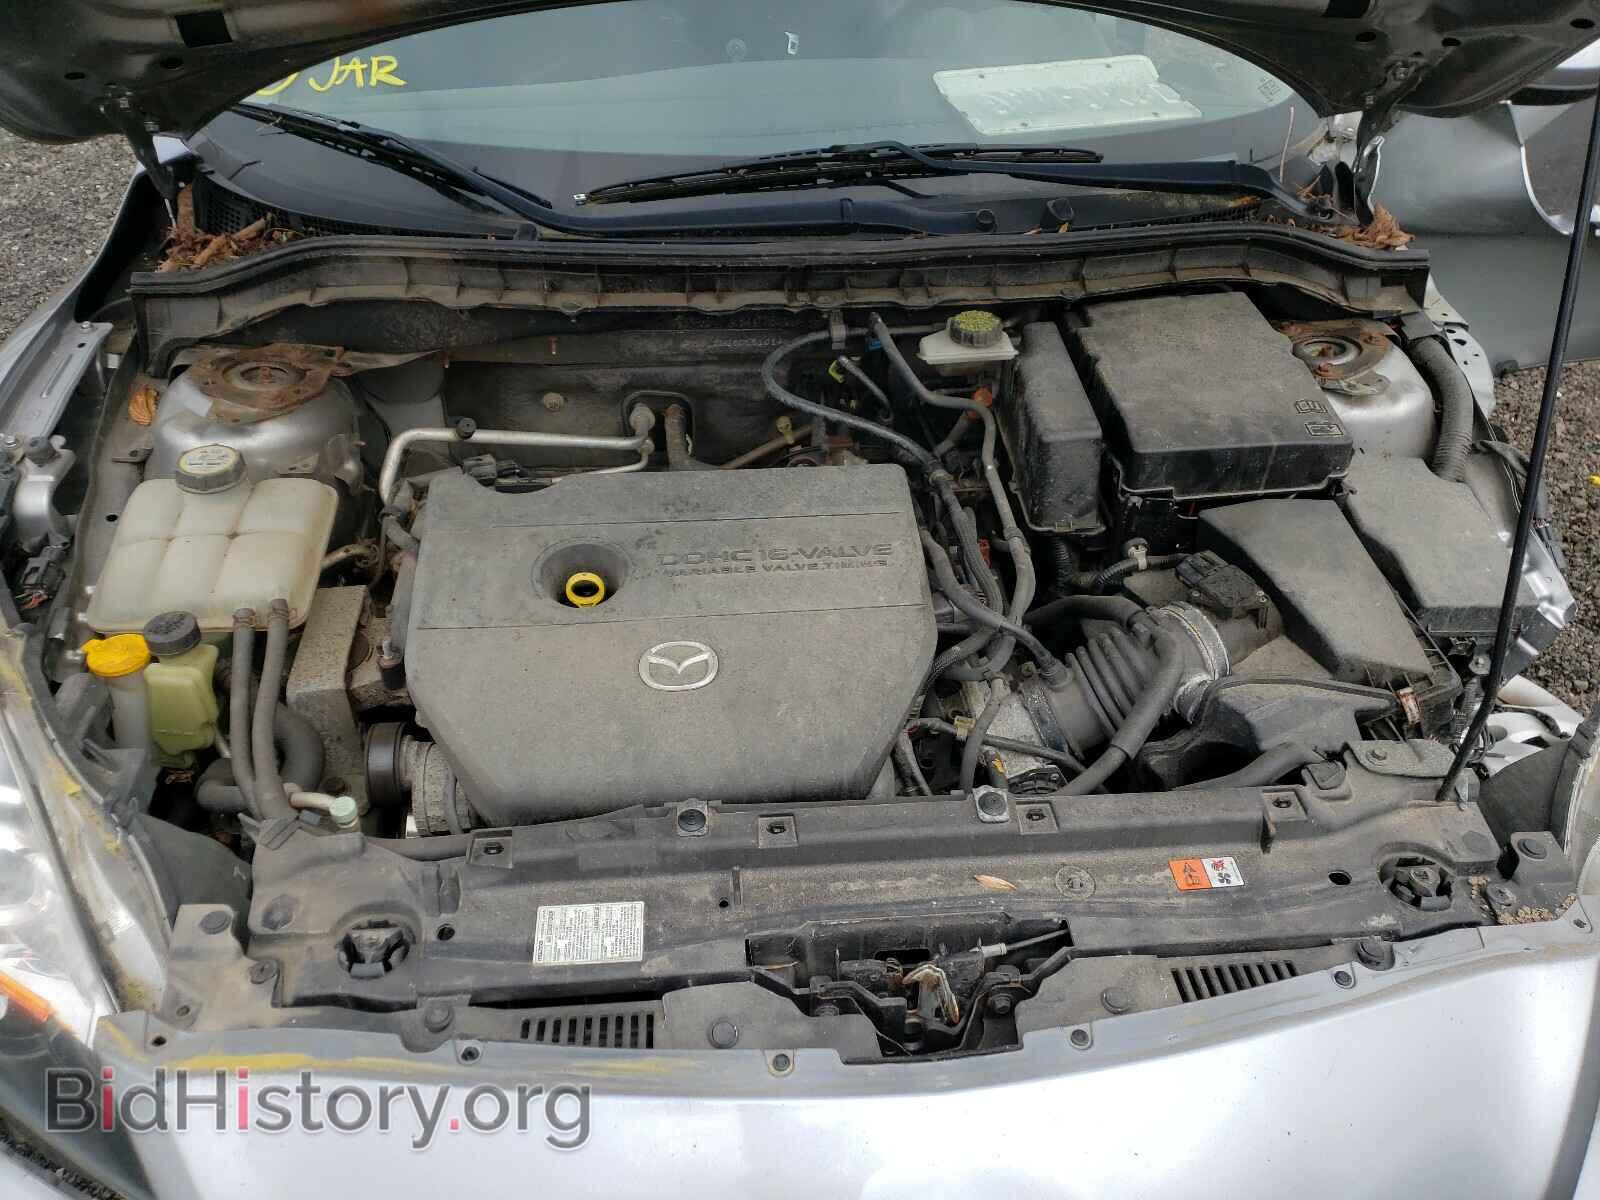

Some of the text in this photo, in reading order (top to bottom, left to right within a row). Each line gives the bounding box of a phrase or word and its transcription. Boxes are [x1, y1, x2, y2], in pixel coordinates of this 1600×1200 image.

[308, 55, 408, 93] JAR
[657, 543, 894, 566] DOHC 16-VALVE
[762, 562, 819, 573] VALVE
